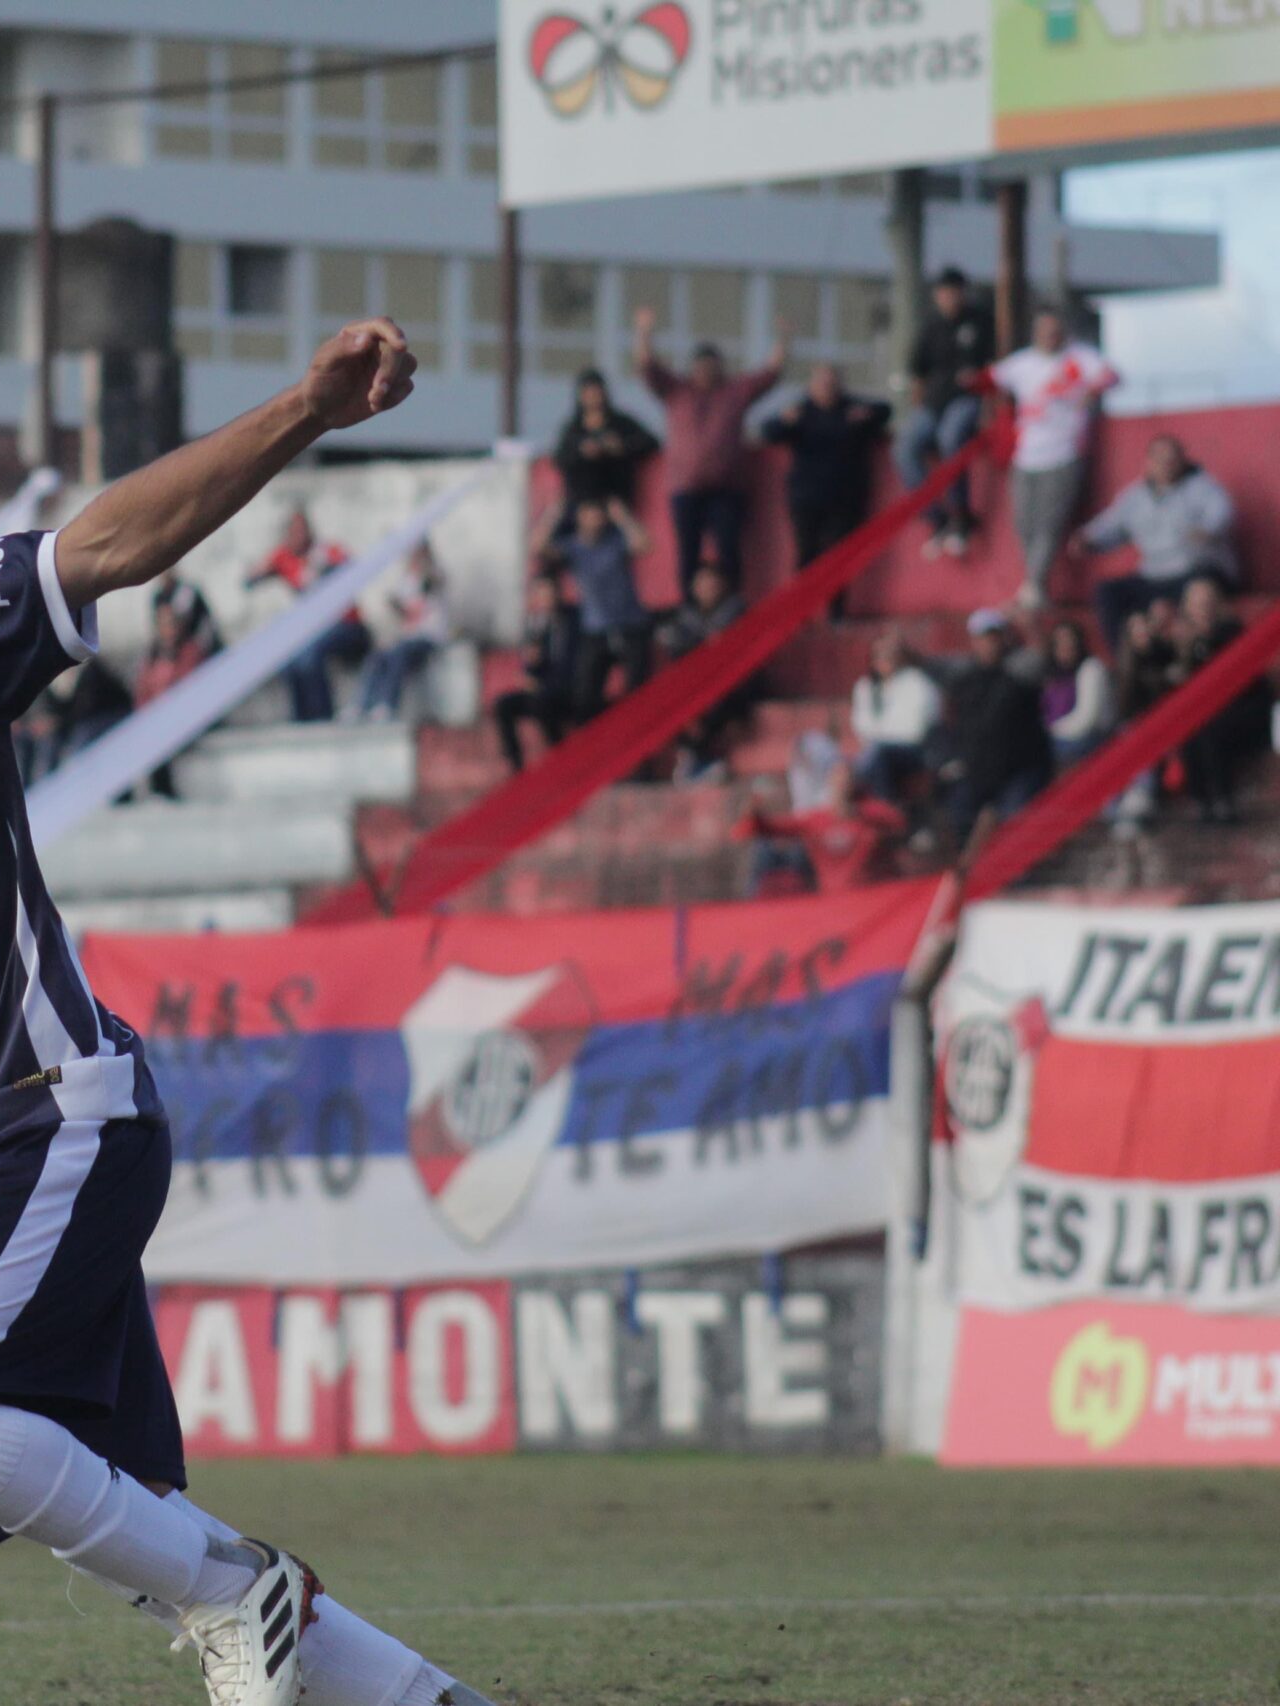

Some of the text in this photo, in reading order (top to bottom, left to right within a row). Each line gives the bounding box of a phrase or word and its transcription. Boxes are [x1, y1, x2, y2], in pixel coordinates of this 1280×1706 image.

[710, 34, 983, 105] Misioneras
[1017, 1184, 1087, 1281] ES
[1104, 1196, 1174, 1292] LA
